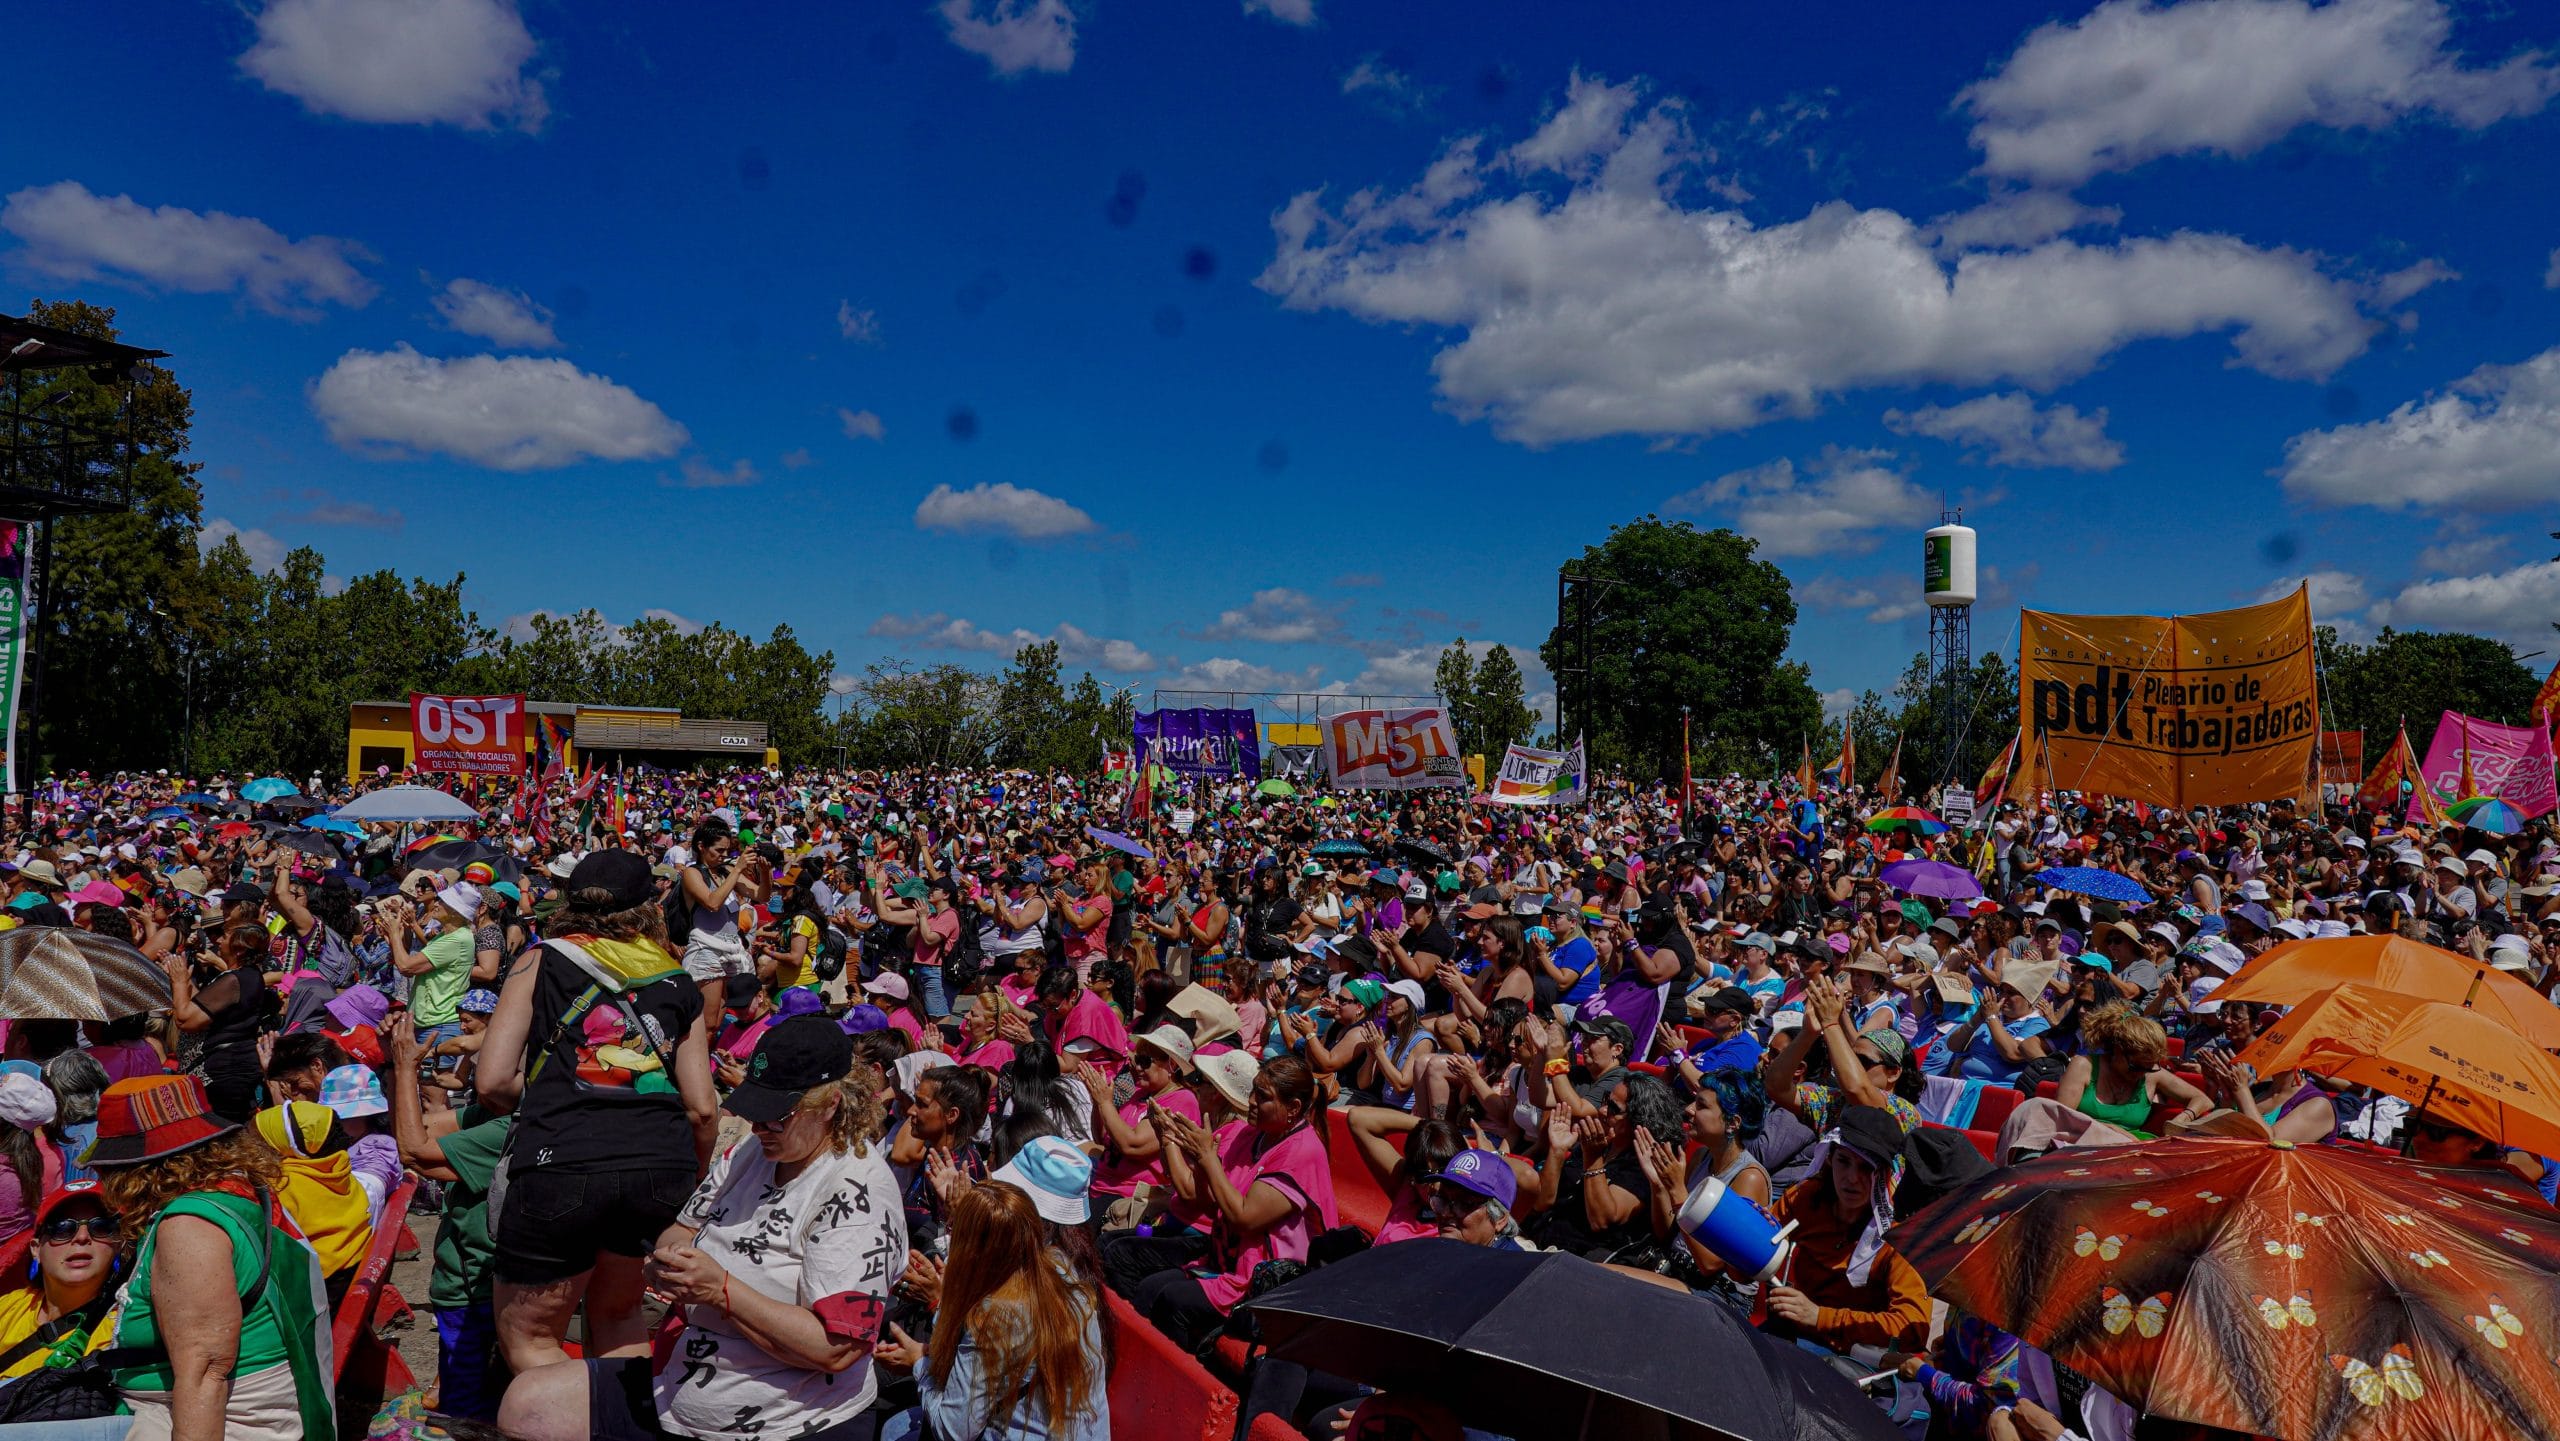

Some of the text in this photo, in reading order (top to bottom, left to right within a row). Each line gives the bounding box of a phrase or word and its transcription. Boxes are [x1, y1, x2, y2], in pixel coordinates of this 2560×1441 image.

[2206, 655, 2229, 665] DE
[2034, 666, 2133, 744] pdt
[2143, 674, 2260, 706] Plenario de
[419, 696, 516, 746] OST
[2142, 697, 2312, 756] Trabajadoras
[422, 749, 517, 762] ORGANIZACIÓN SOCIALISTA
[1344, 715, 1445, 770] MST
[432, 760, 510, 772] DE LOS TRABAJADORES
[1506, 756, 1542, 783] LIBRE
